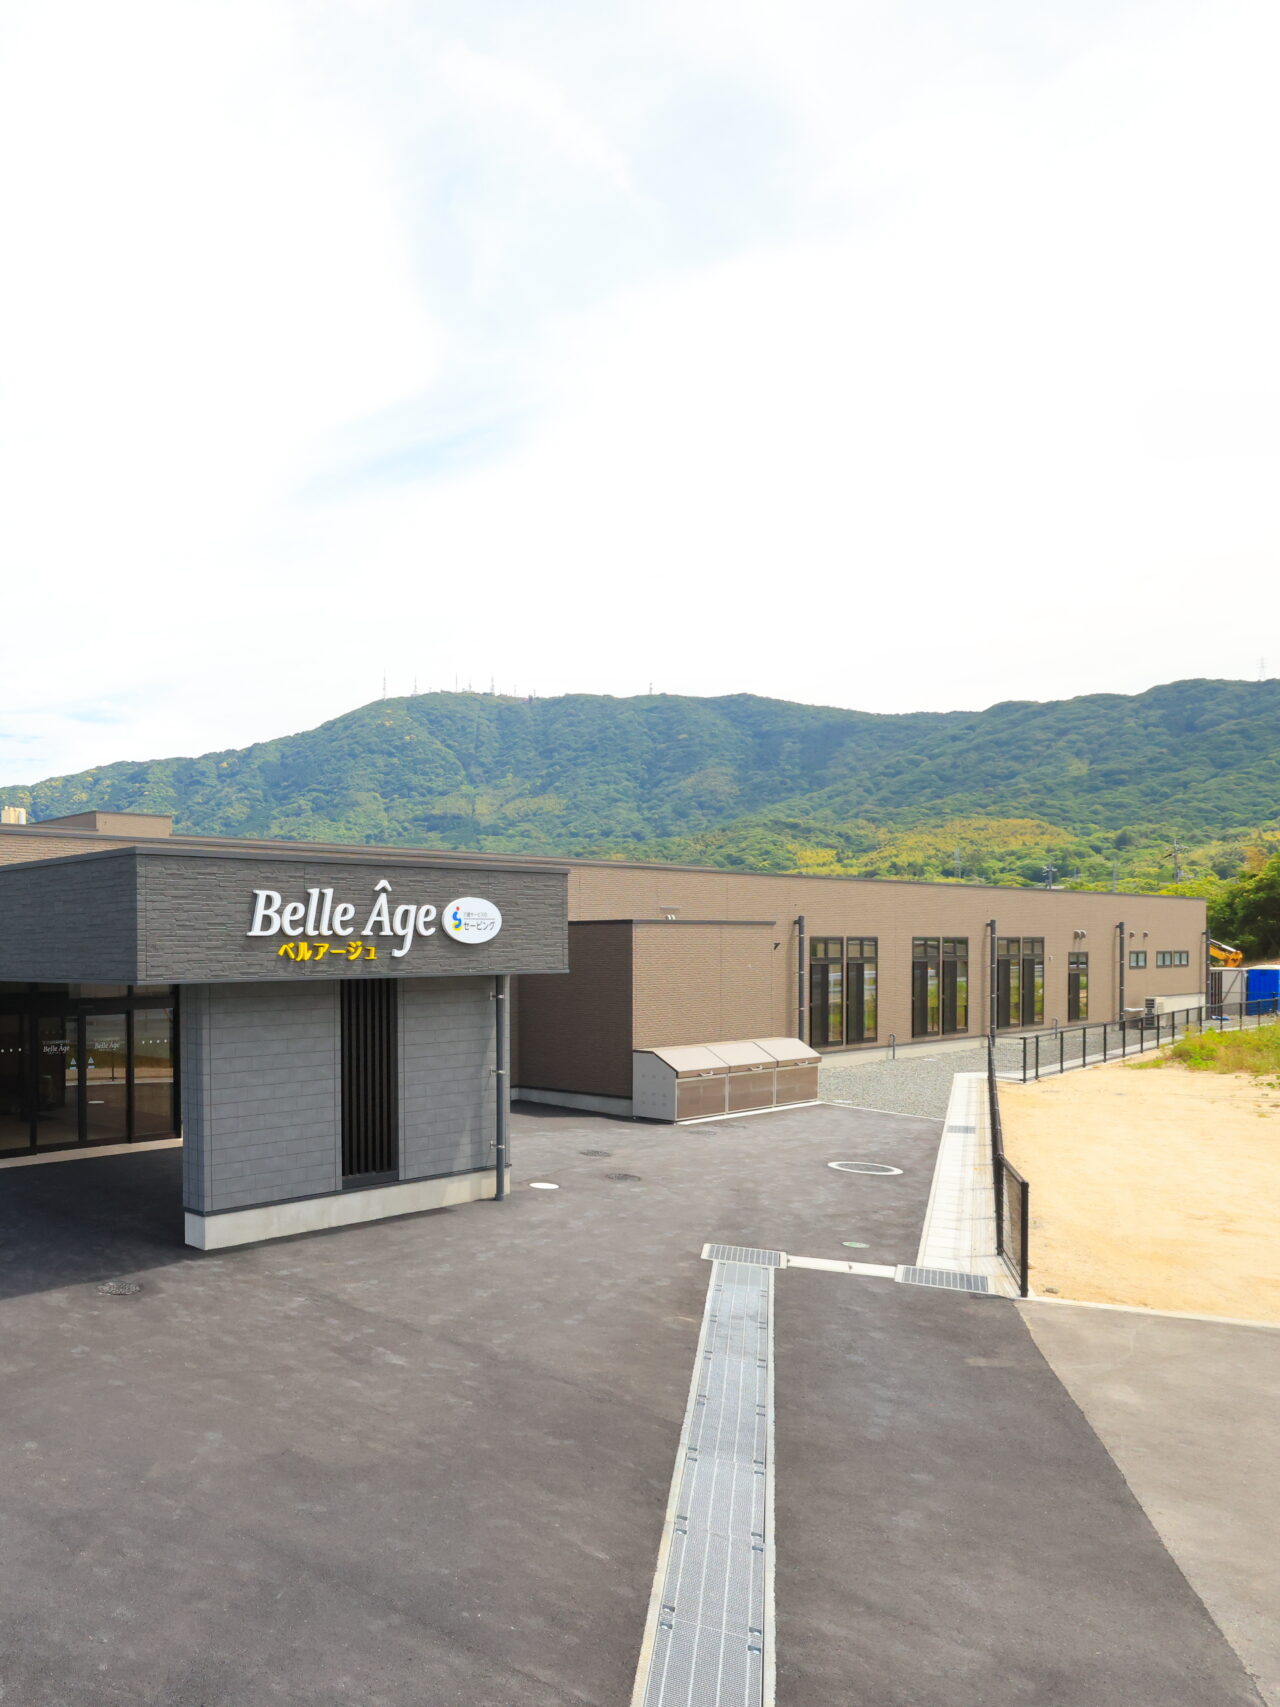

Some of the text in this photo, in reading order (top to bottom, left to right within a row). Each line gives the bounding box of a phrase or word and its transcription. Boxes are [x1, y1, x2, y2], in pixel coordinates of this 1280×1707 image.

[246, 879, 436, 958] Belle Âge
[463, 920, 496, 931] セービング
[277, 941, 378, 962] ベルアージュ
[42, 1045, 58, 1053] Belle
